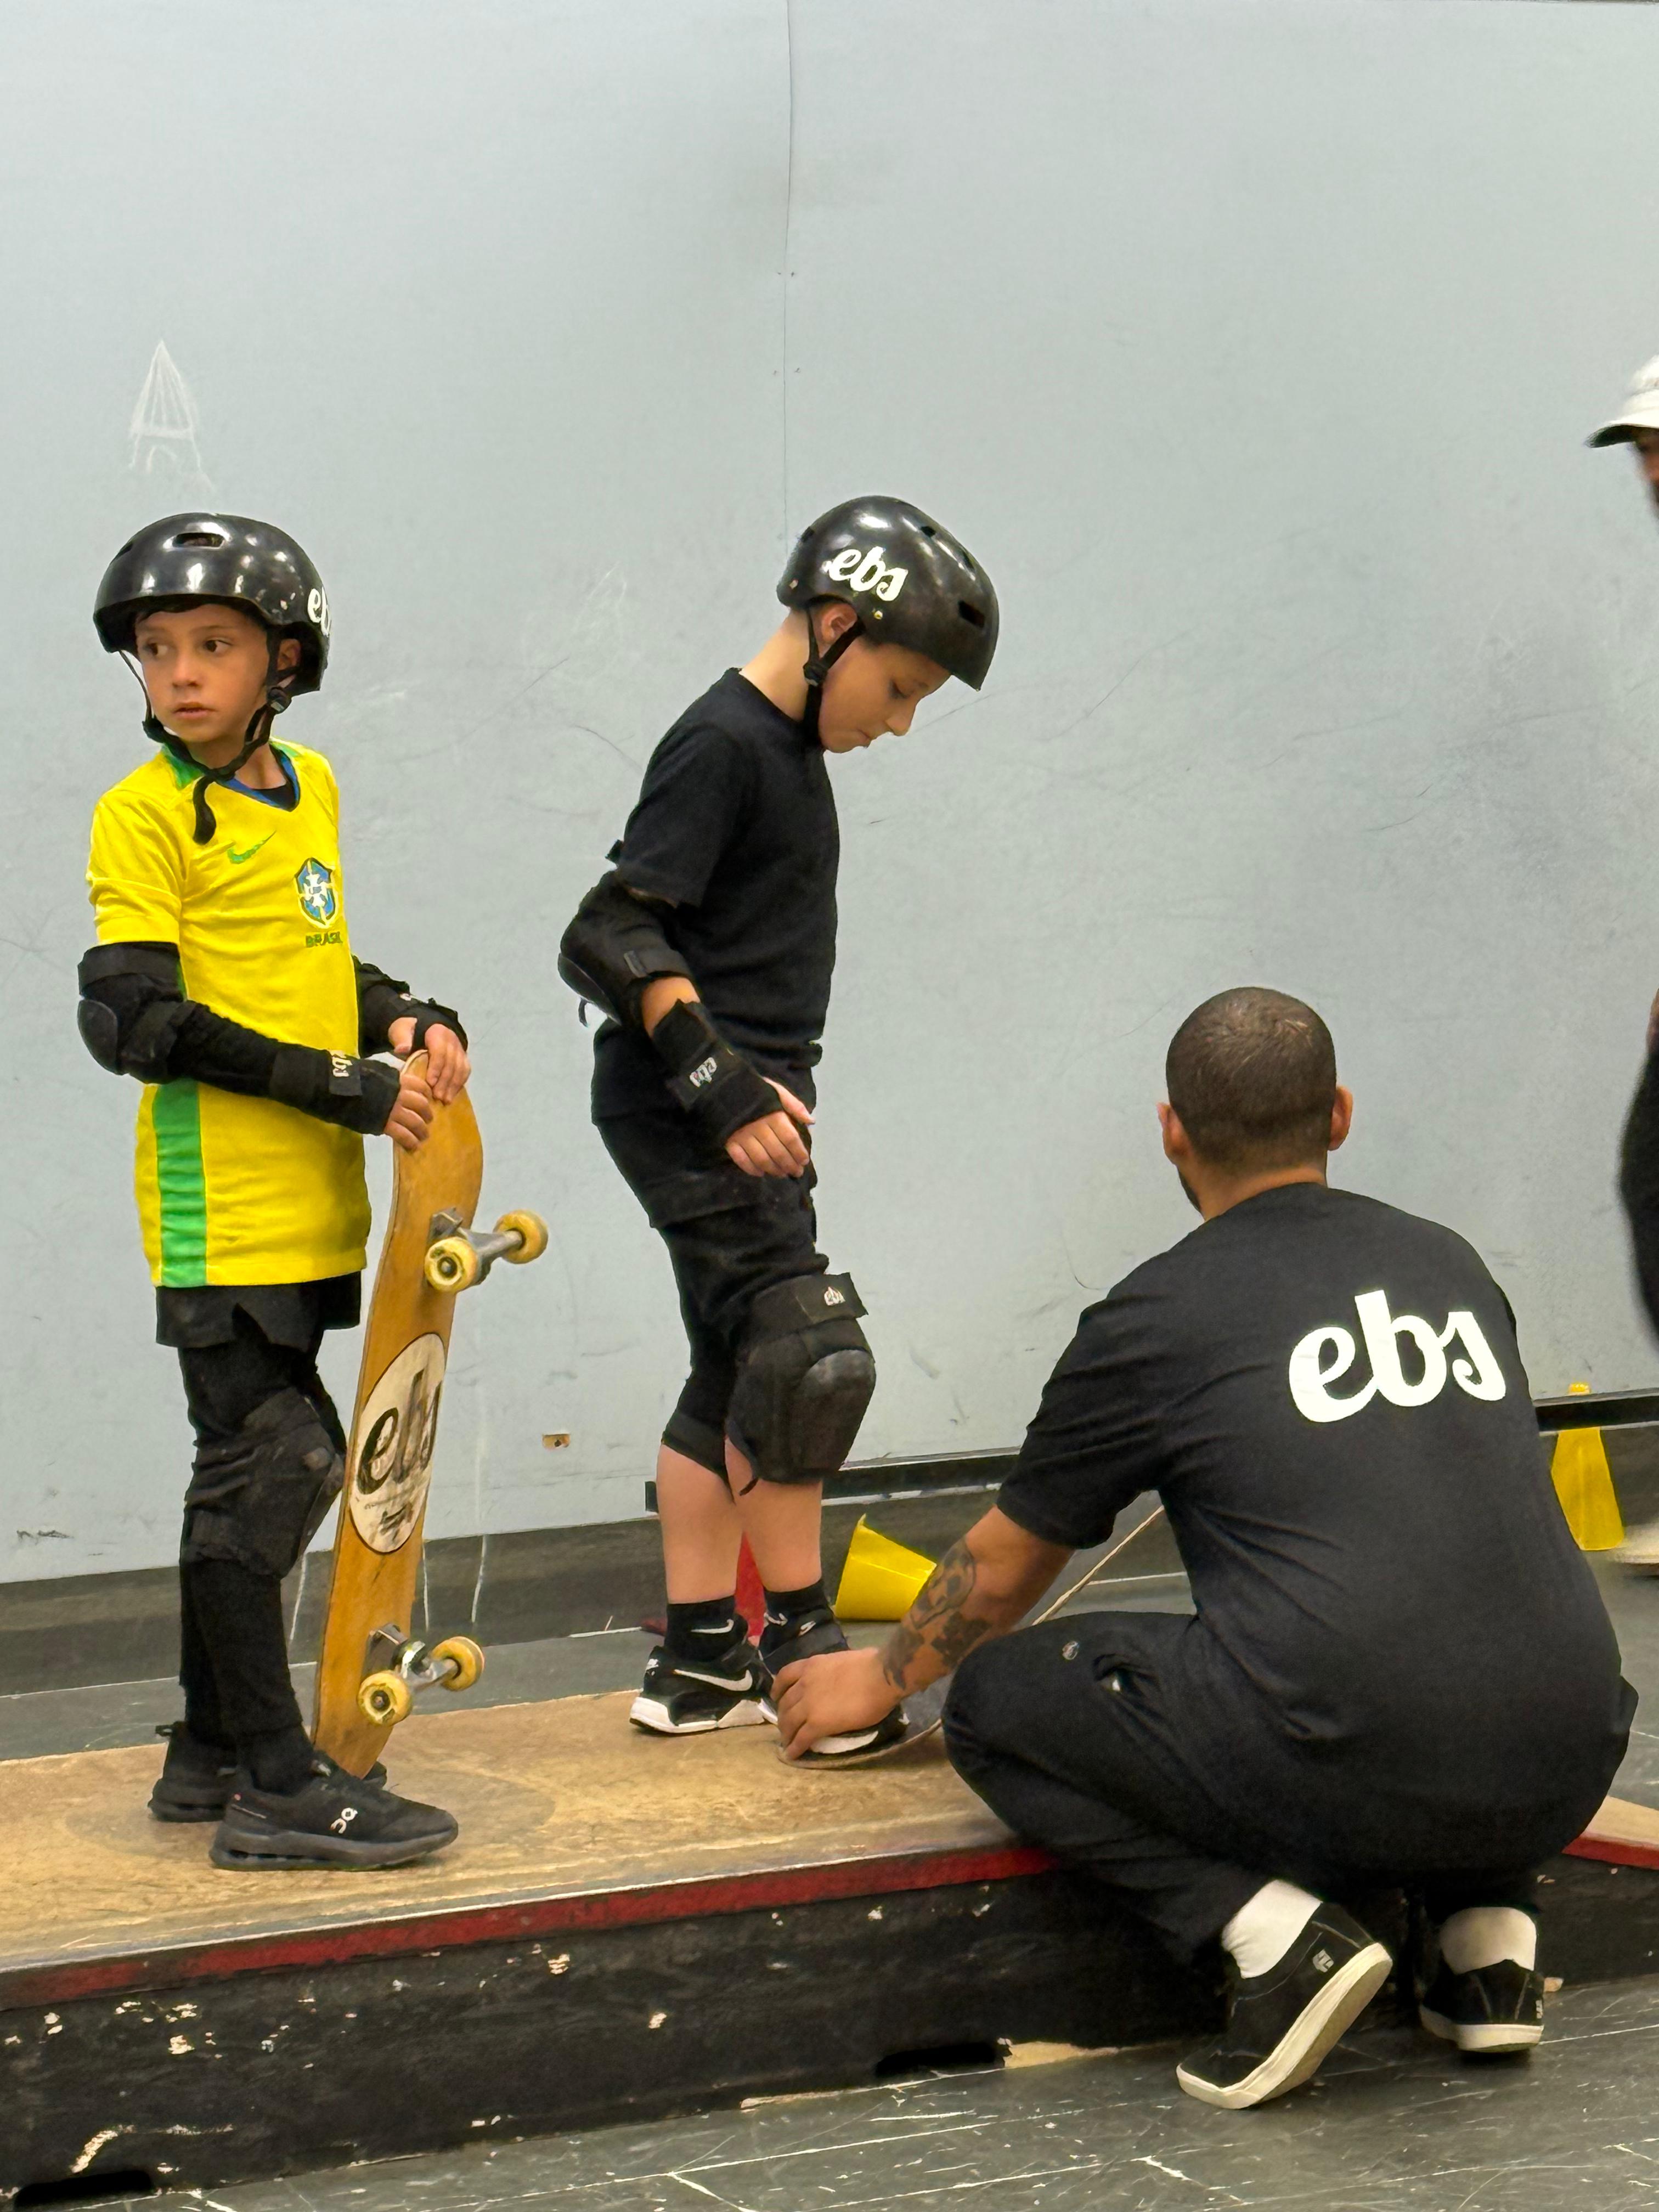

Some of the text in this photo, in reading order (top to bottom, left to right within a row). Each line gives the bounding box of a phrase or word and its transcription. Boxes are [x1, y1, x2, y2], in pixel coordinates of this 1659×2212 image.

[828, 546, 909, 601] ebs
[308, 586, 332, 637] eb
[1289, 1290, 1506, 1423] ebs
